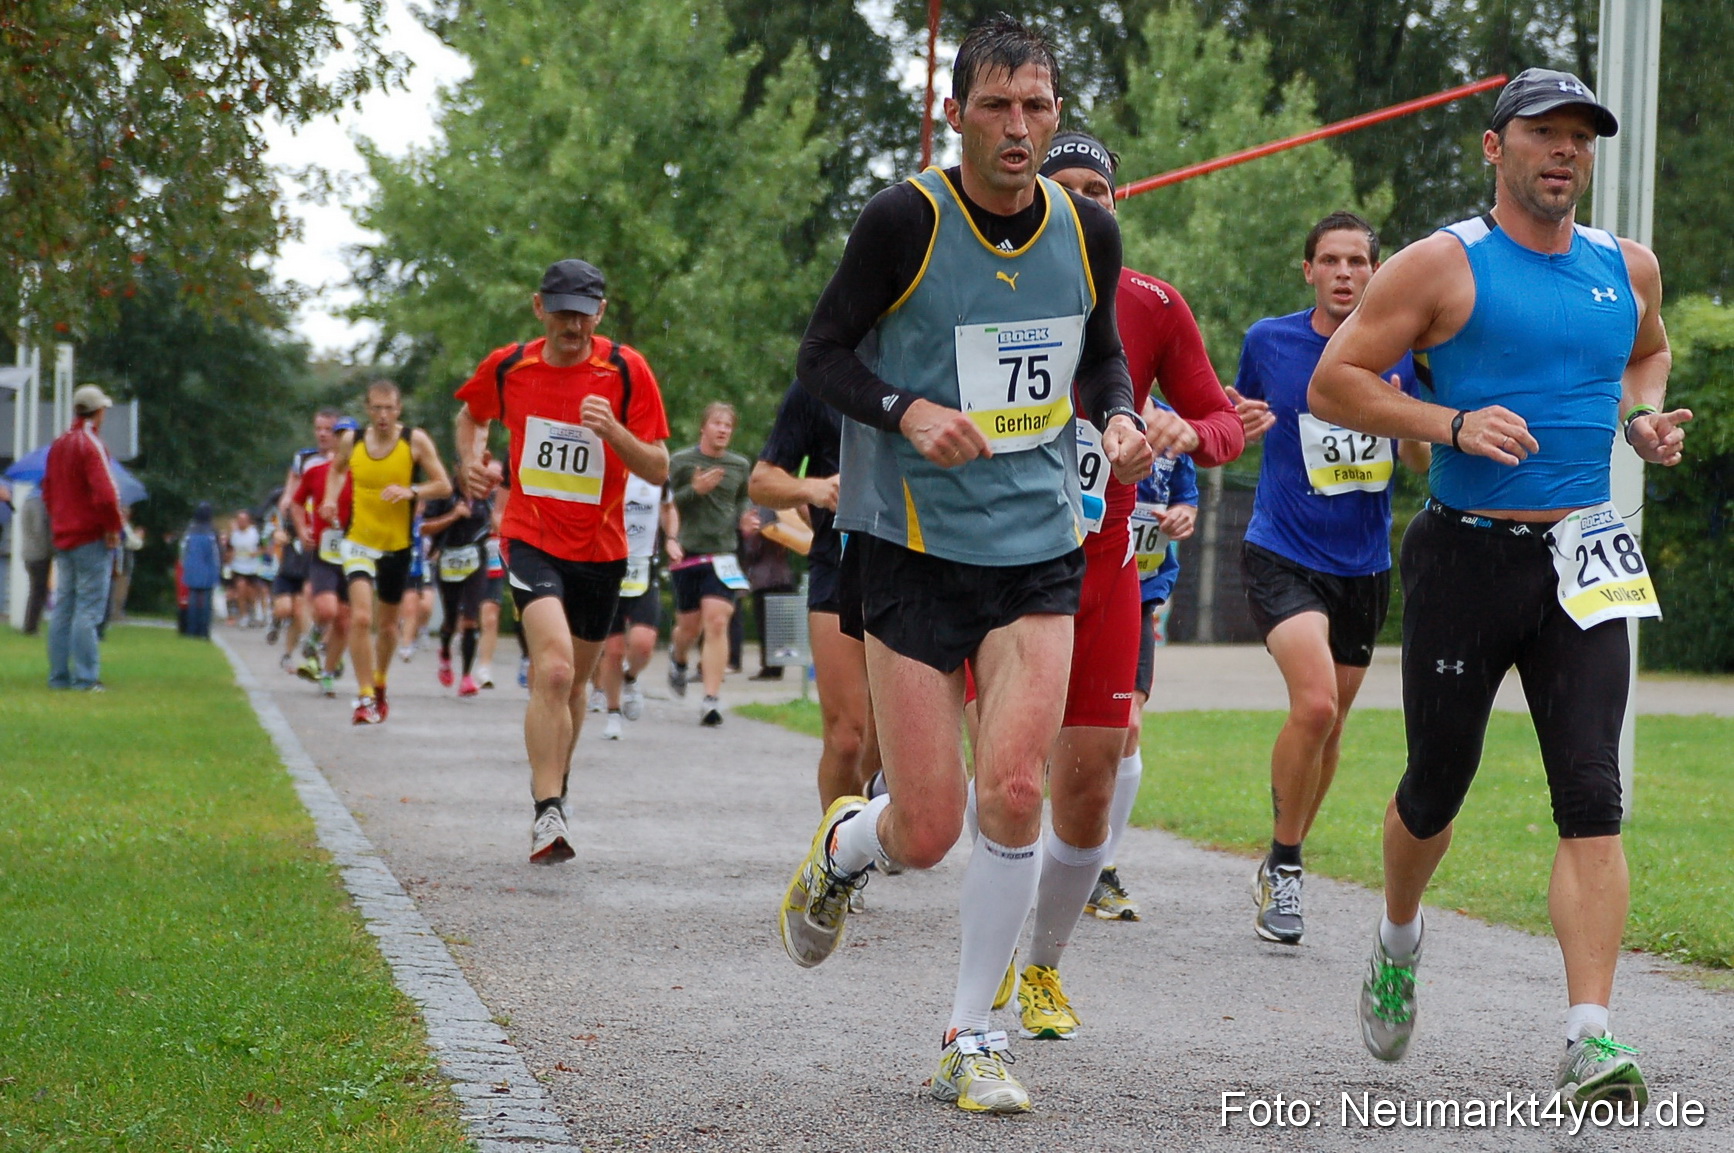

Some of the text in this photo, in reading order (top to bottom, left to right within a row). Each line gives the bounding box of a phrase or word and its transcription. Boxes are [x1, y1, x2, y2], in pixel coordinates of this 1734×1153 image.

[1130, 277, 1170, 304] cocoon
[998, 327, 1049, 344] BOCK
[998, 354, 1051, 403] 75
[537, 441, 589, 474] 810
[1322, 433, 1378, 463] 312
[1334, 469, 1374, 481] Fabian
[1581, 510, 1615, 530] BOCK
[1575, 532, 1644, 588] 218
[1600, 587, 1648, 603] Volker
